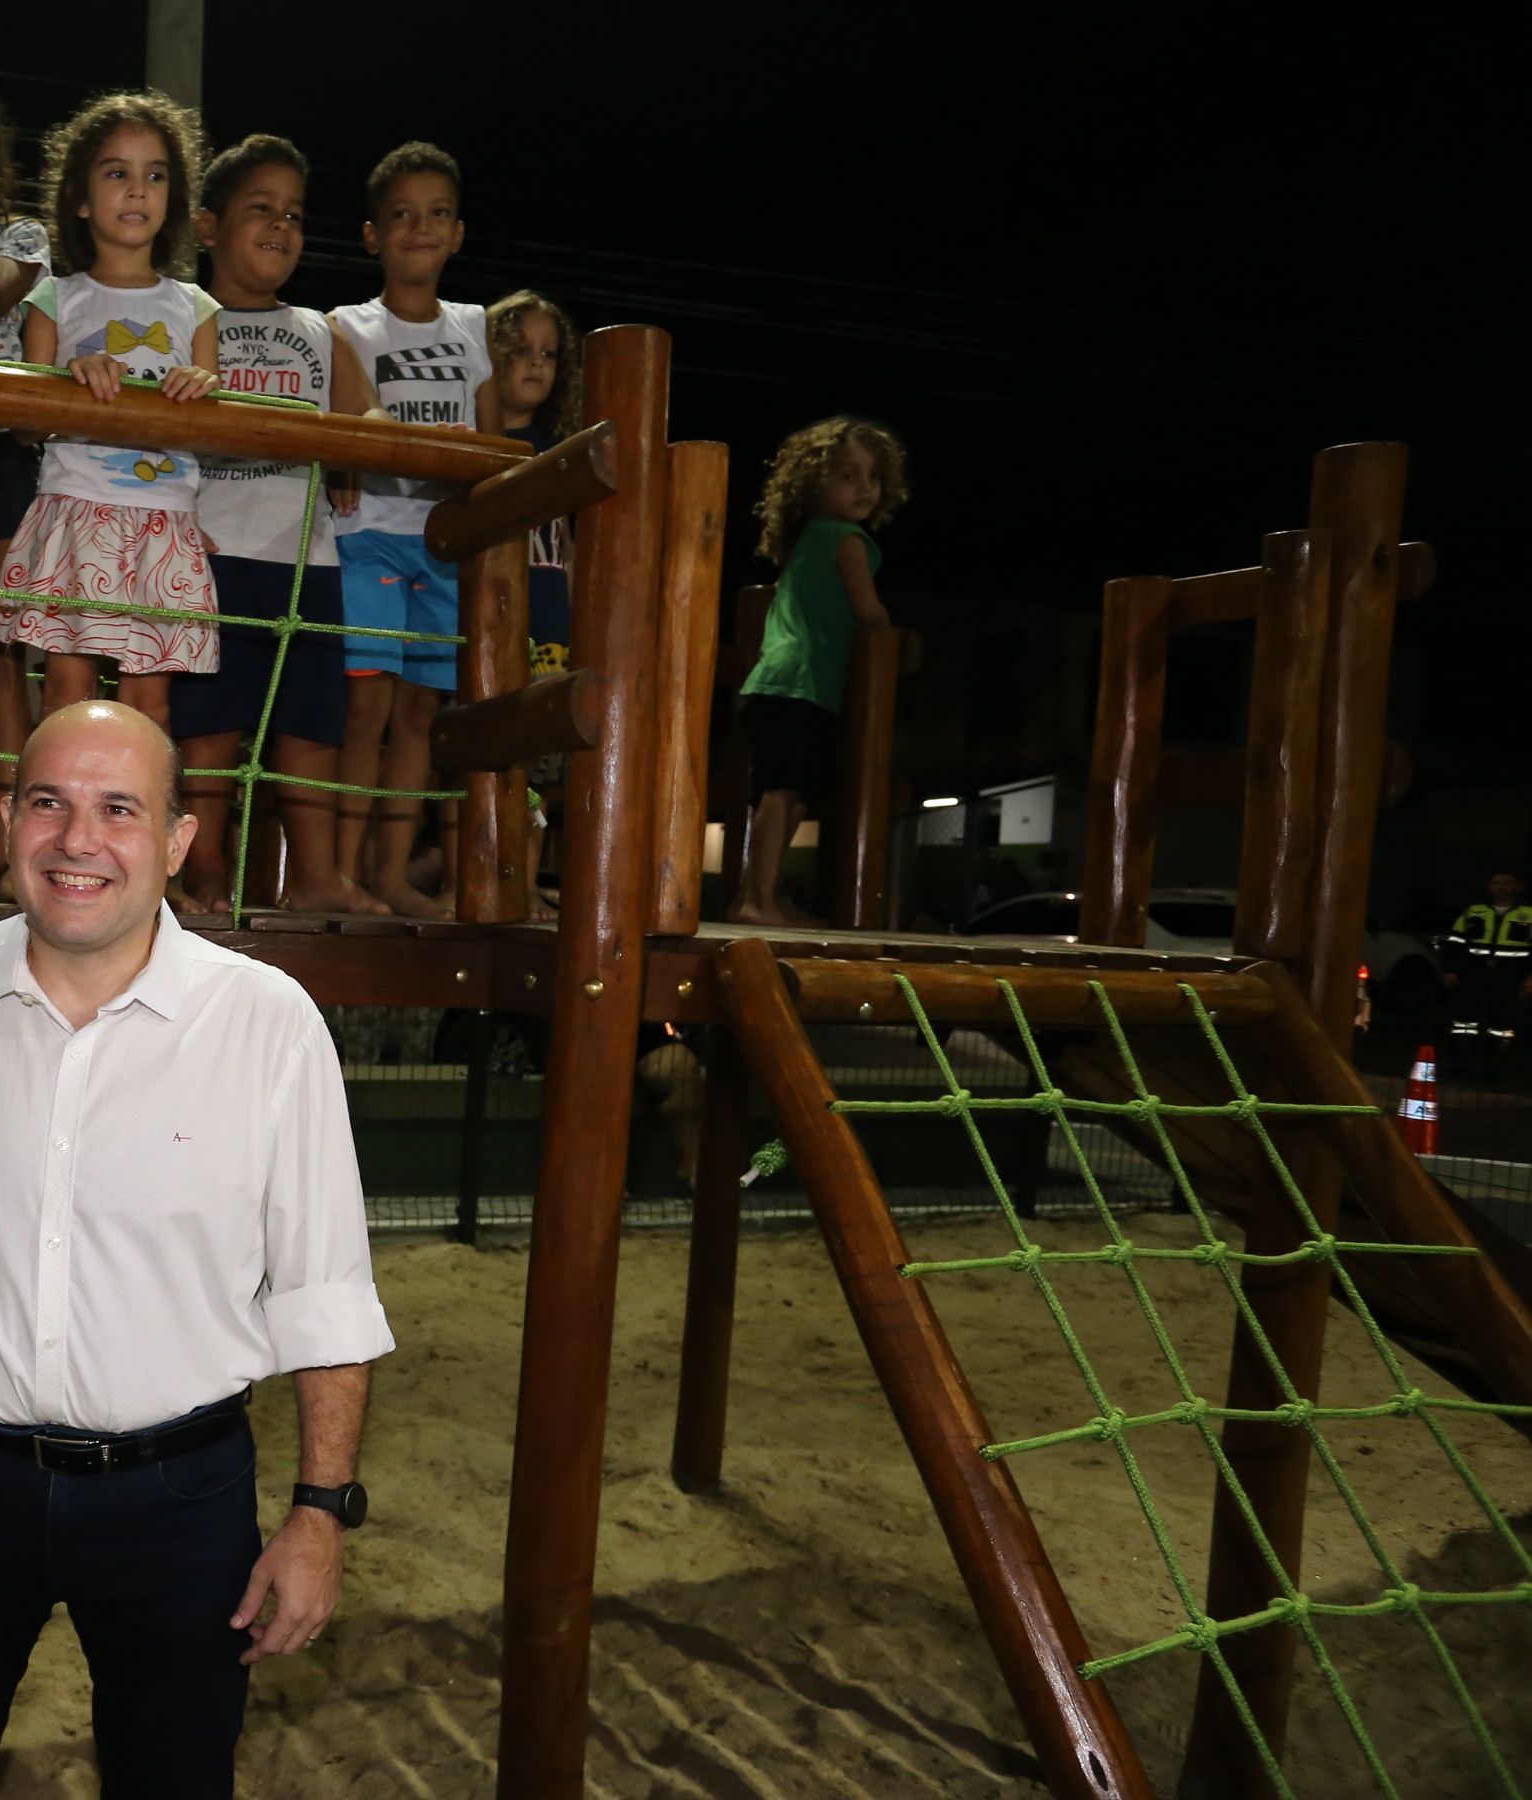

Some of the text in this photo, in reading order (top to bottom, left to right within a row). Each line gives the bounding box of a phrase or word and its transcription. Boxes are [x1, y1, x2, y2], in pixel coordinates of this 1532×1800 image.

[218, 325, 324, 390] YORK RIDERS
[251, 355, 293, 367] Power
[275, 370, 301, 394] TO
[230, 463, 299, 480] CHAMPI
